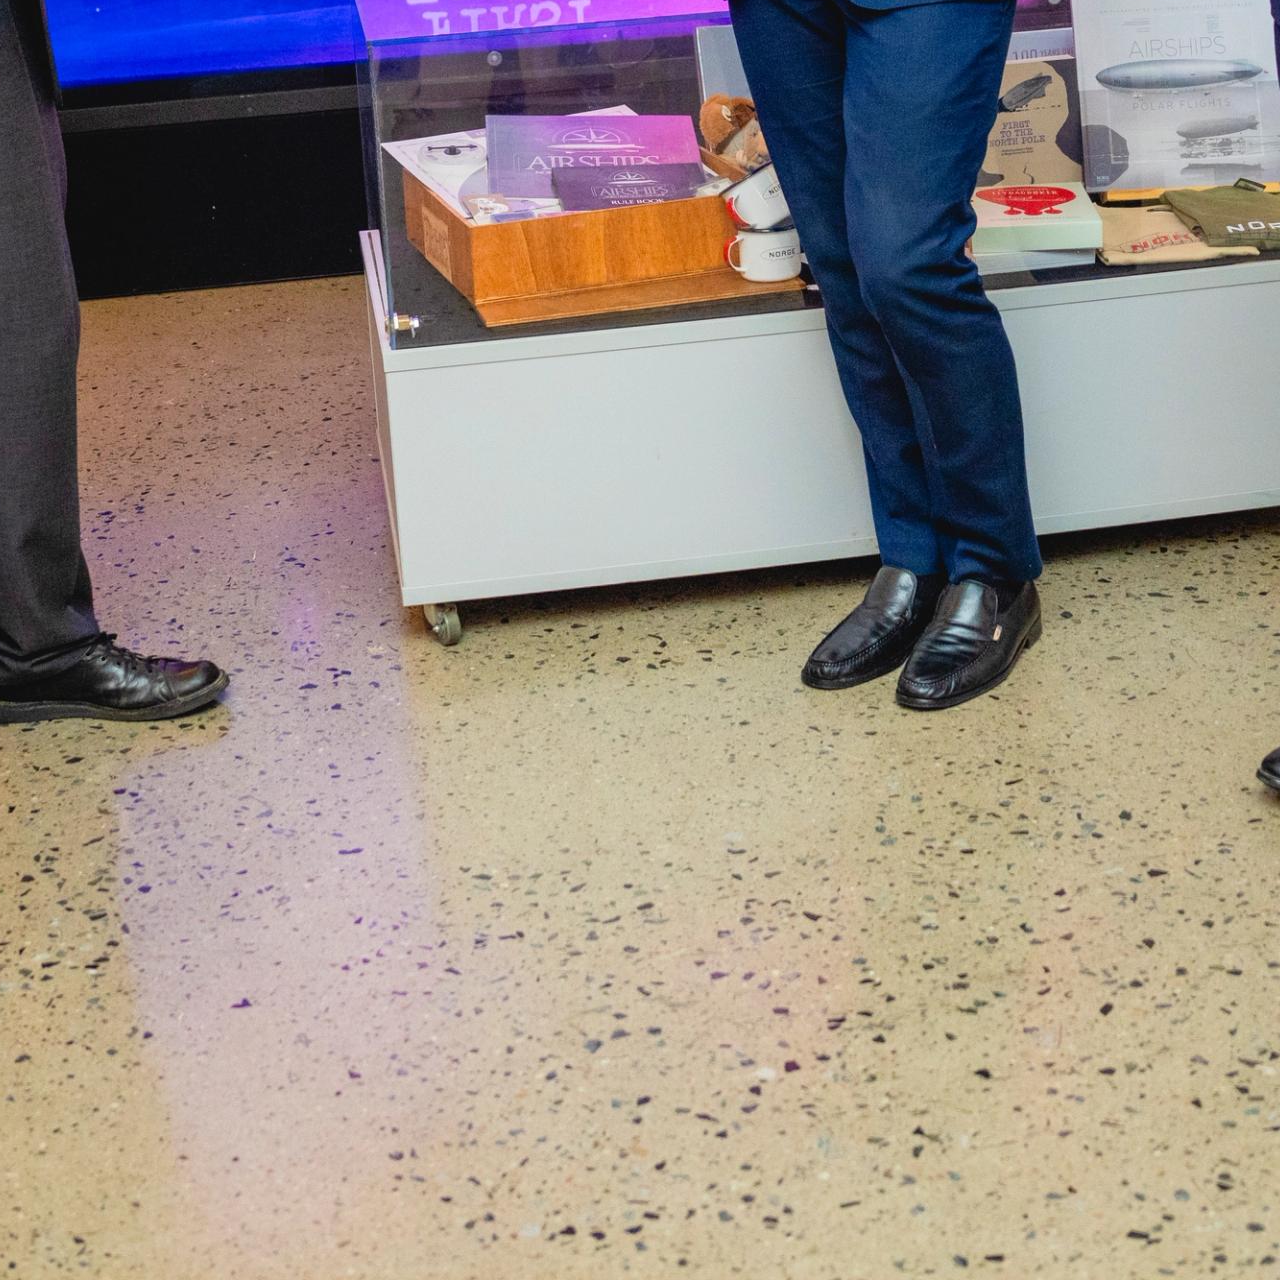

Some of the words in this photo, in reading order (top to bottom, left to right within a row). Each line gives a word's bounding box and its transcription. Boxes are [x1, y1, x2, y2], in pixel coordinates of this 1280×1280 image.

[1128, 36, 1227, 59] AIRSHIPS
[1132, 101, 1173, 111] POLAR
[1180, 98, 1232, 108] FLIGHTS
[1002, 120, 1031, 129] FIRST
[1000, 130, 1011, 138] TO
[1014, 129, 1033, 137] THE
[1022, 135, 1046, 144] POLE
[595, 185, 669, 198] AIRSHIPS
[769, 247, 796, 258] NORGE
